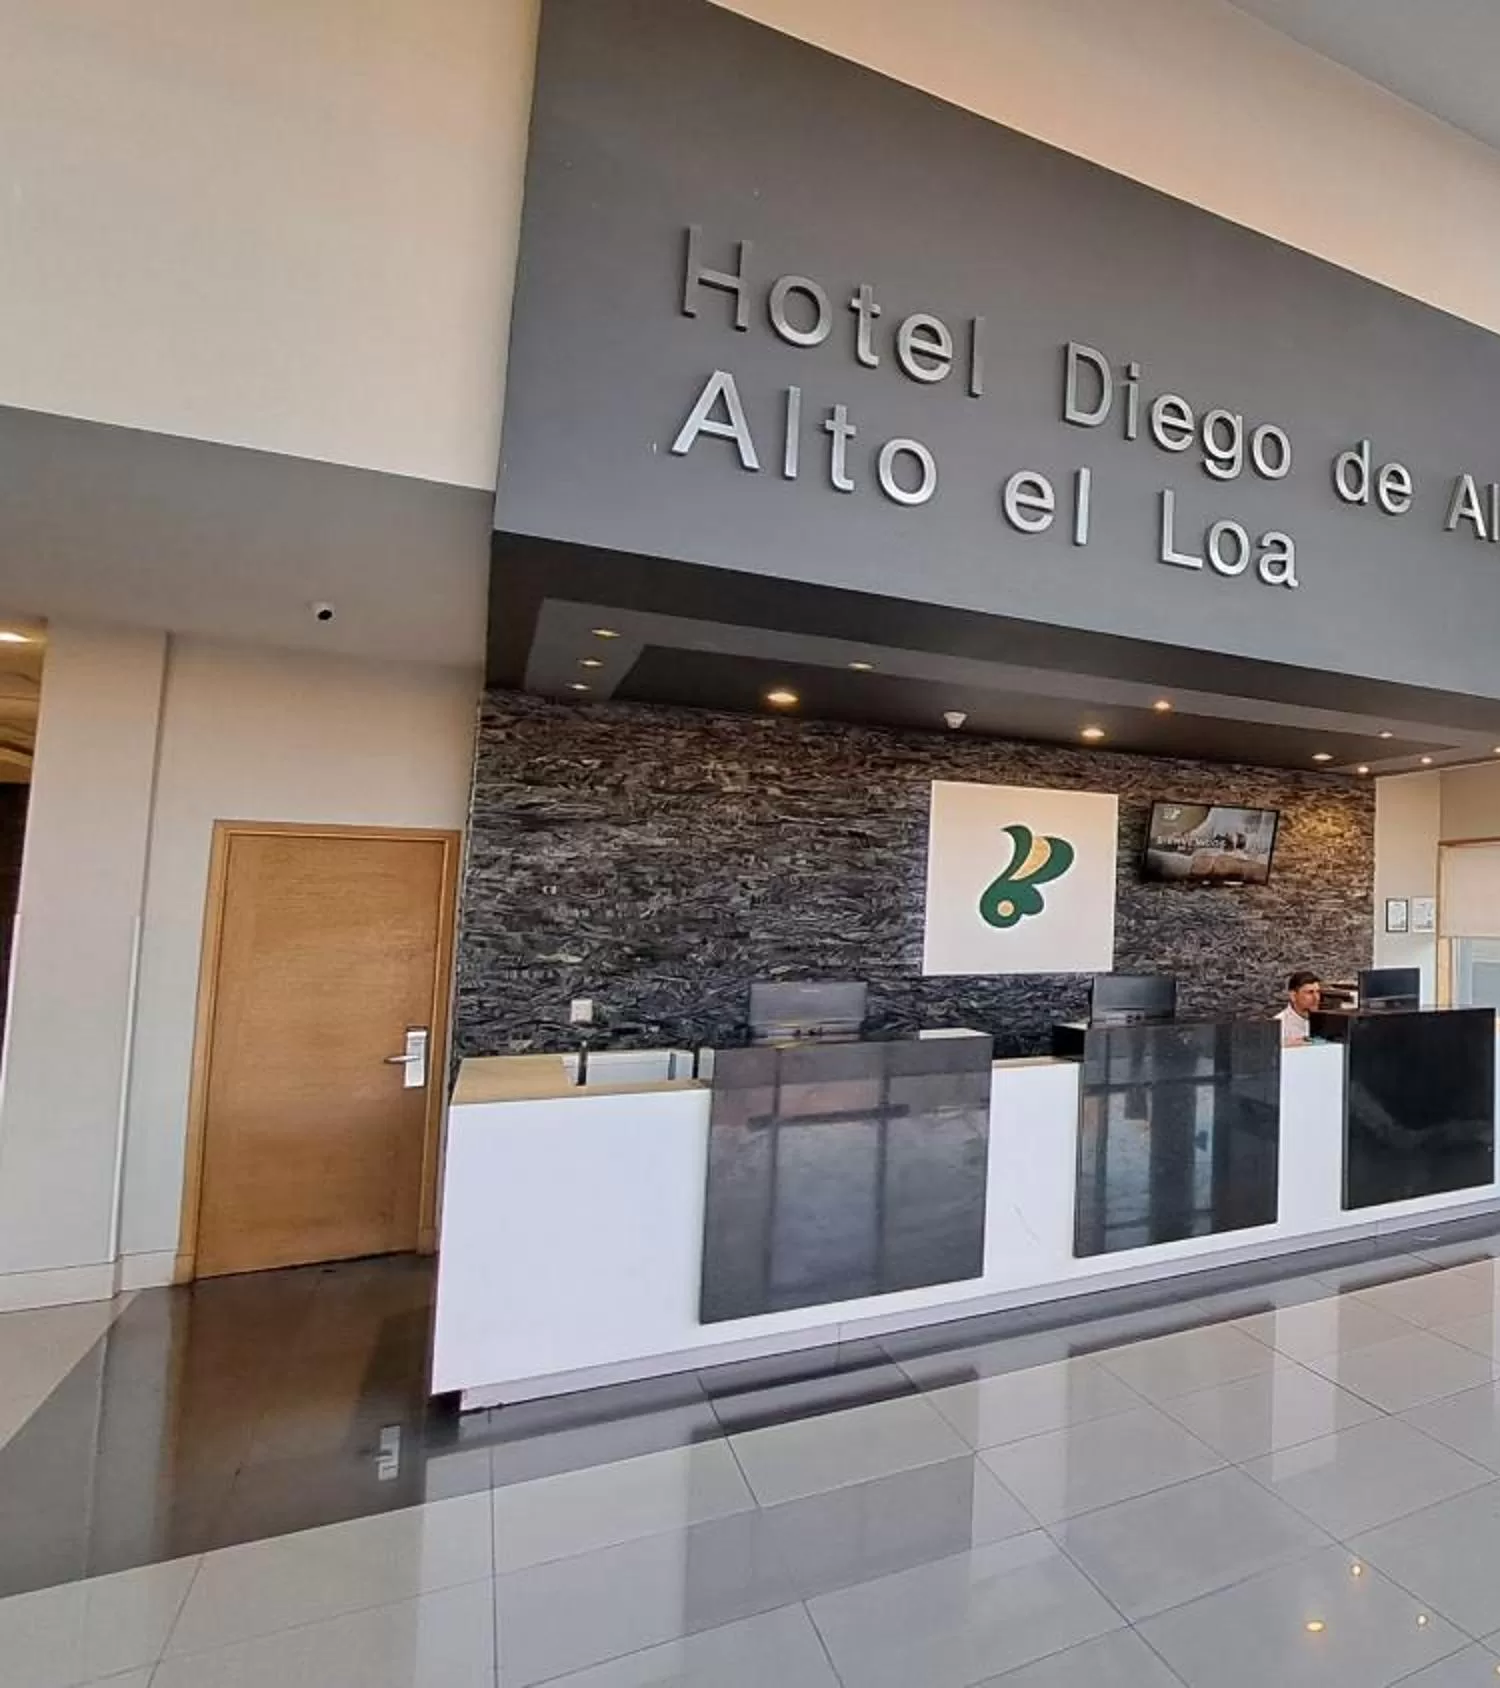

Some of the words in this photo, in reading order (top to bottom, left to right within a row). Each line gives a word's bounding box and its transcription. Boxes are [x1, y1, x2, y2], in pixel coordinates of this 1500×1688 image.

[671, 370, 939, 506] Alto
[1002, 467, 1091, 546] el
[1157, 489, 1299, 589] Loa
[681, 225, 985, 399] Hotel
[1062, 341, 1292, 480] Diego
[1333, 440, 1413, 515] de
